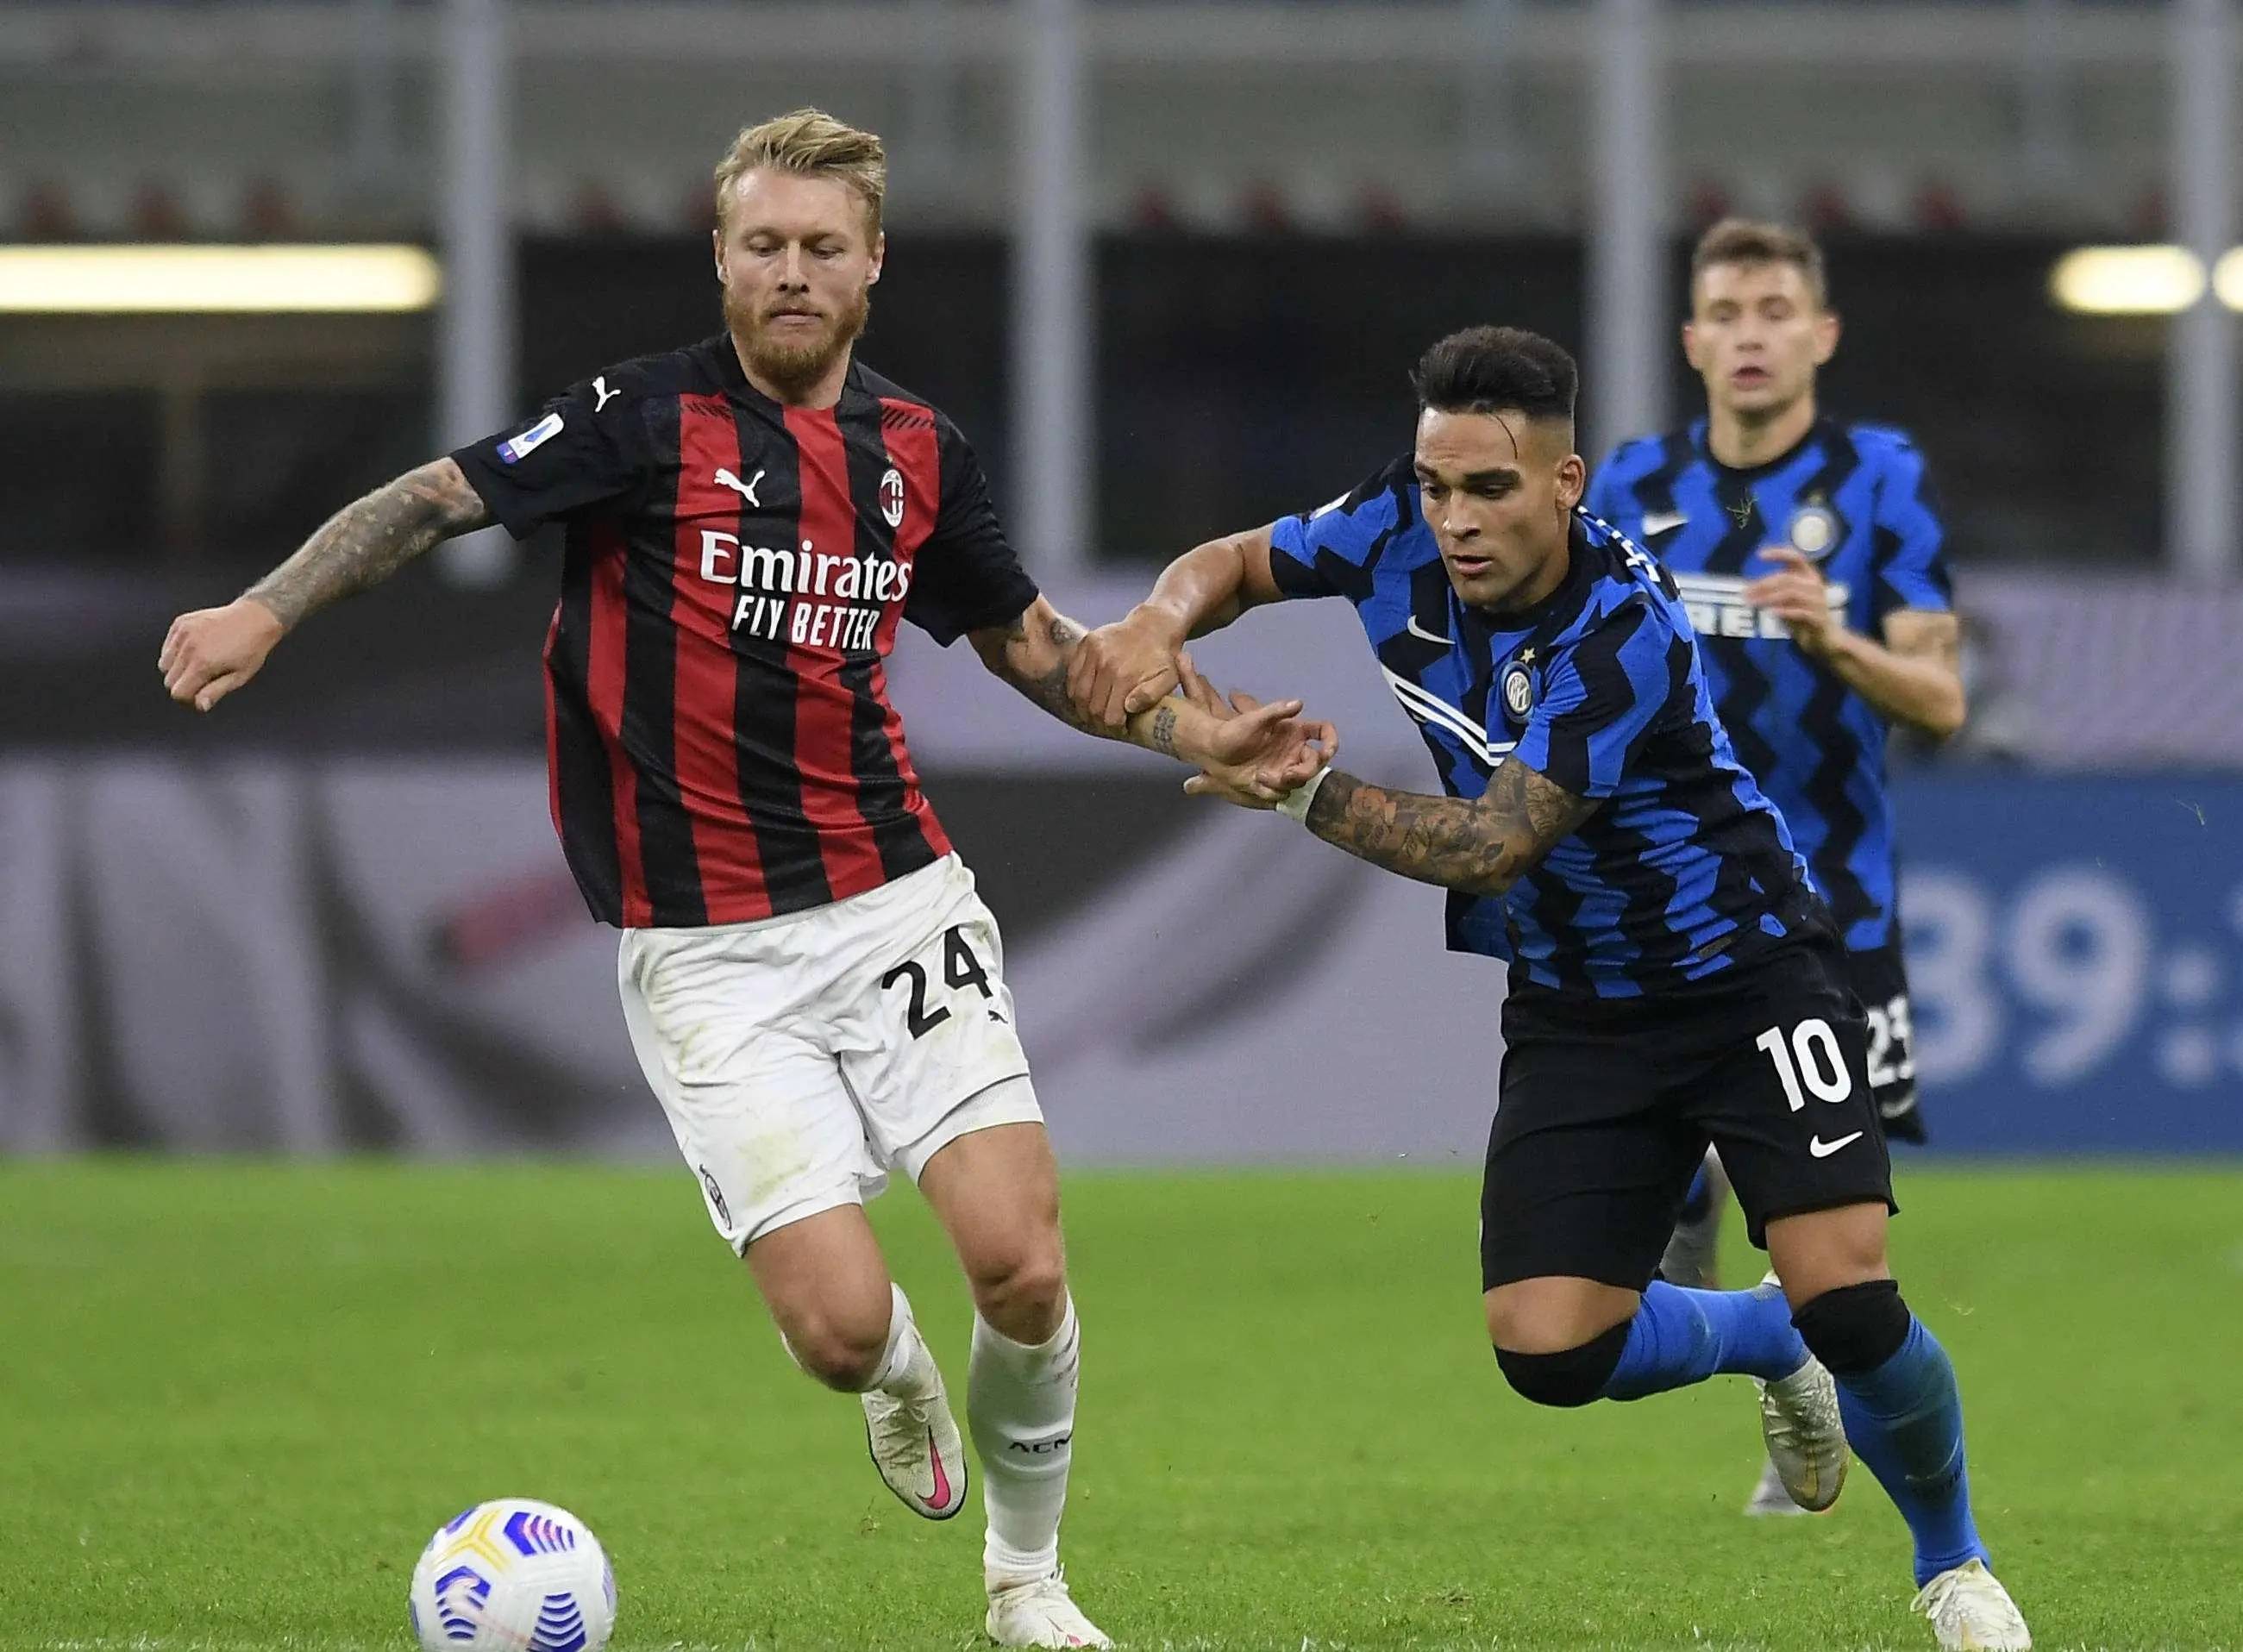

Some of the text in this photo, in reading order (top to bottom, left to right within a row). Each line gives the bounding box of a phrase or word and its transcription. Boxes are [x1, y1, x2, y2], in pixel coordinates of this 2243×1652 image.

[700, 529, 912, 603] Emirates
[731, 595, 880, 651] FLY BETTER
[881, 923, 993, 1041] 24
[1756, 1018, 1851, 1113] 10
